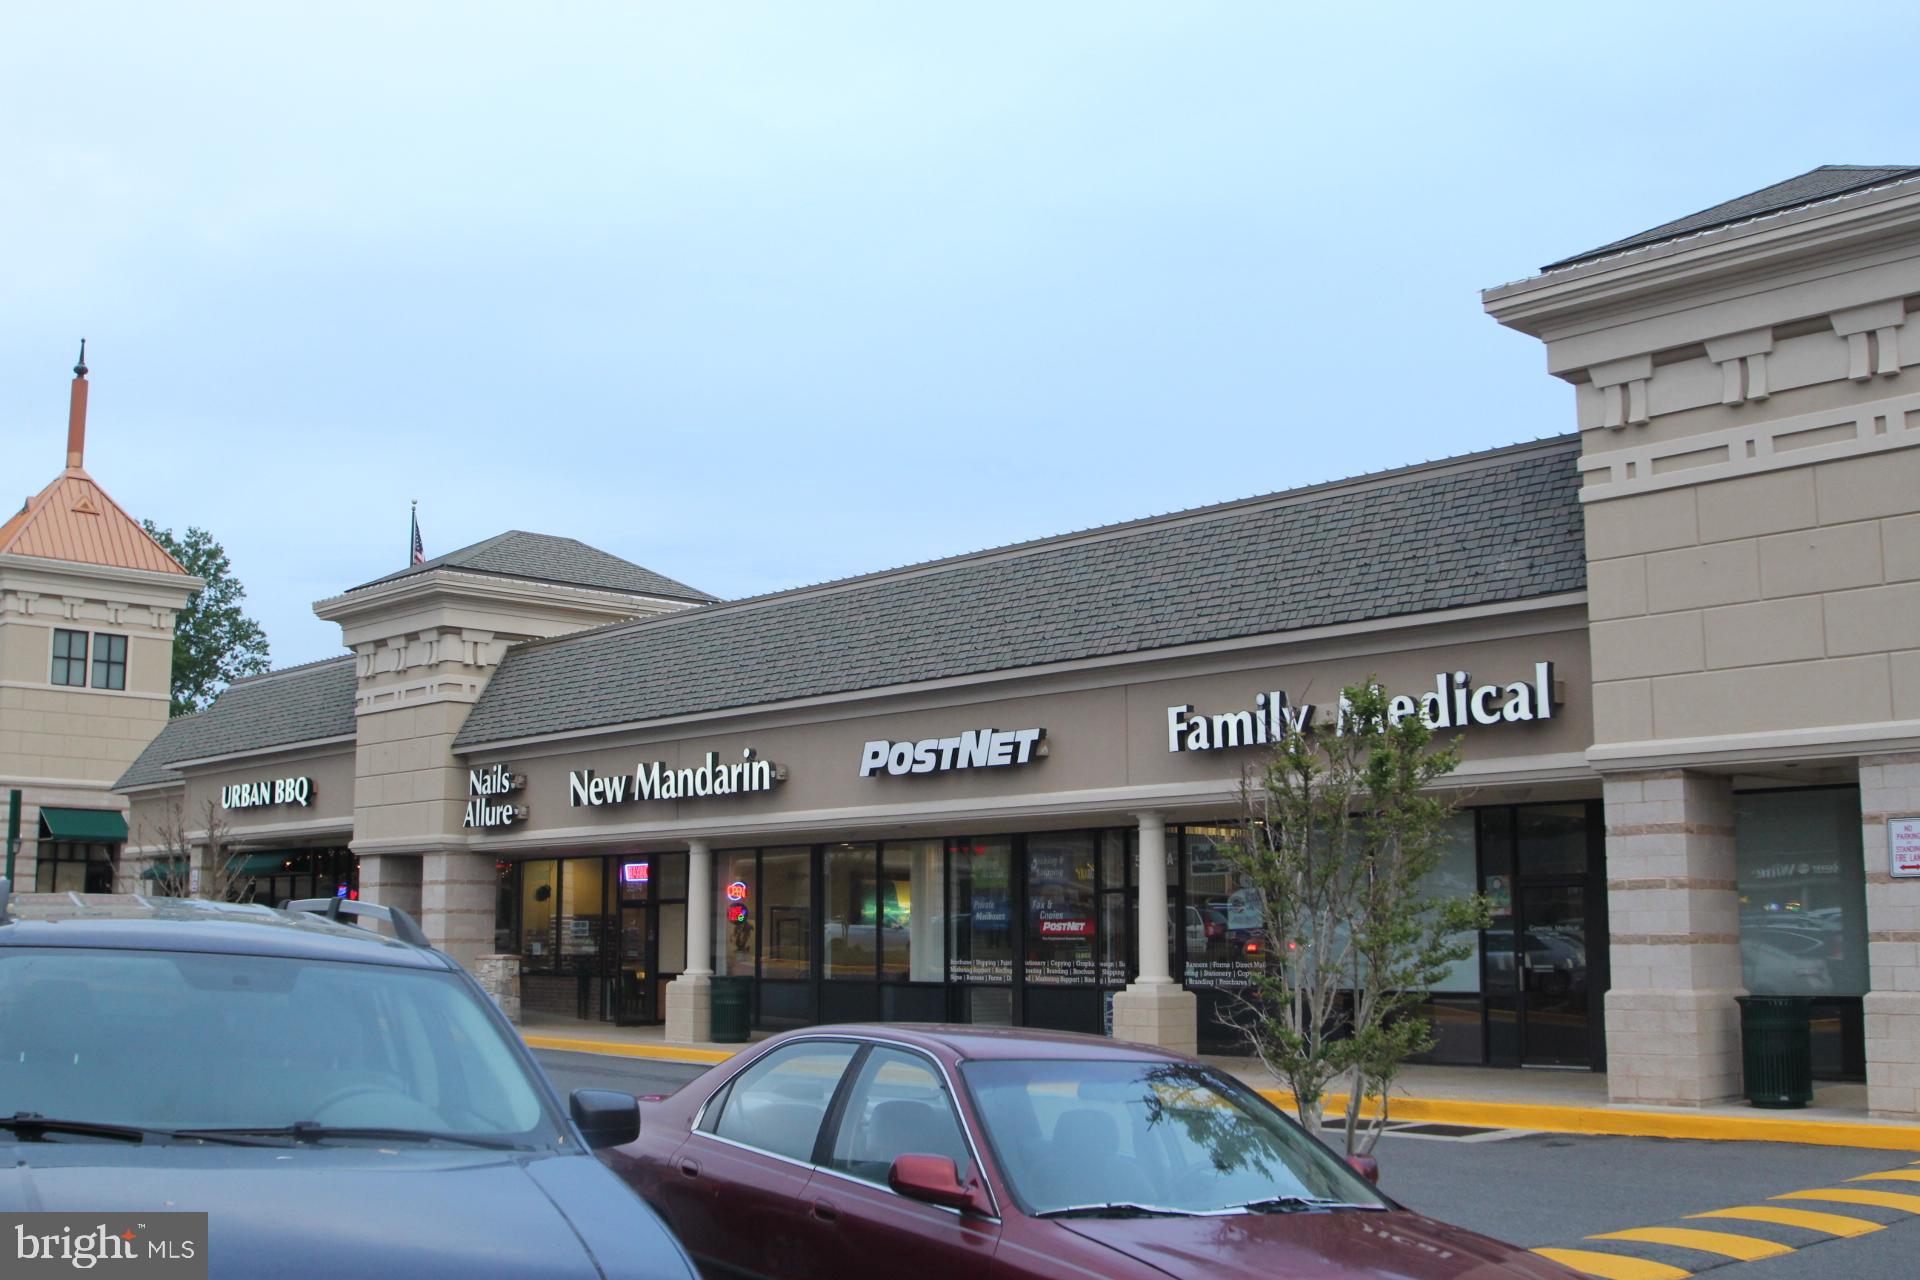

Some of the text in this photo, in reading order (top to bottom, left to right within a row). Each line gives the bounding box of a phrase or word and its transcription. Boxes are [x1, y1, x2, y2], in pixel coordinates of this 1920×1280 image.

[1167, 690, 1313, 754] Family
[221, 776, 309, 809] URBAN BBQ
[469, 764, 511, 797] Nails
[569, 748, 771, 807] New Mandarin
[463, 798, 513, 828] Allure
[727, 885, 746, 898] OPEN
